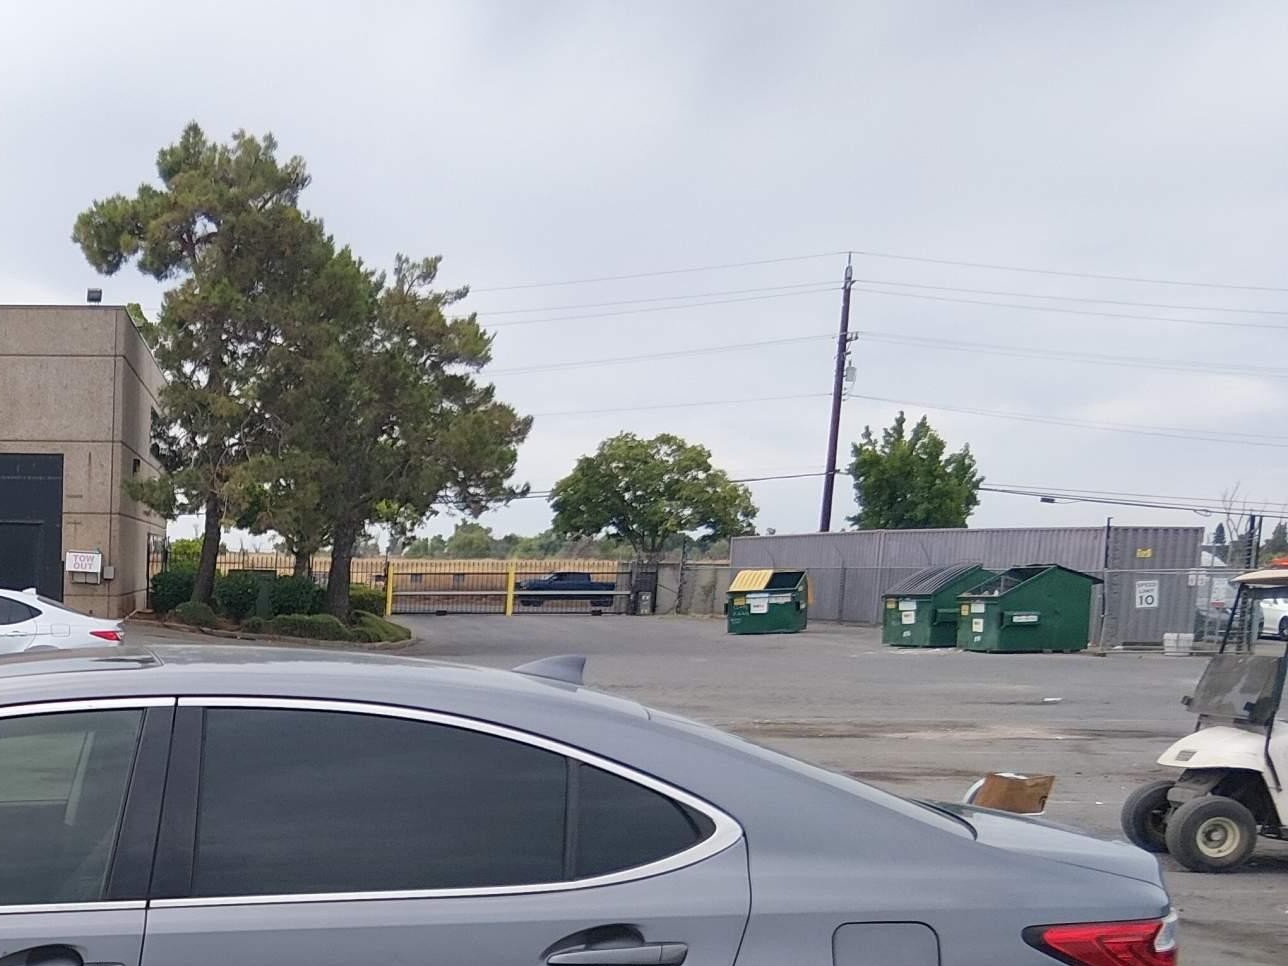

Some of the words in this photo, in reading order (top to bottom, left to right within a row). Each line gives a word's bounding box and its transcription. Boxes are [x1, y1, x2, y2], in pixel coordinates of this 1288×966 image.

[72, 554, 95, 563] TOW
[73, 562, 94, 570] OUT
[1138, 594, 1155, 606] 10
